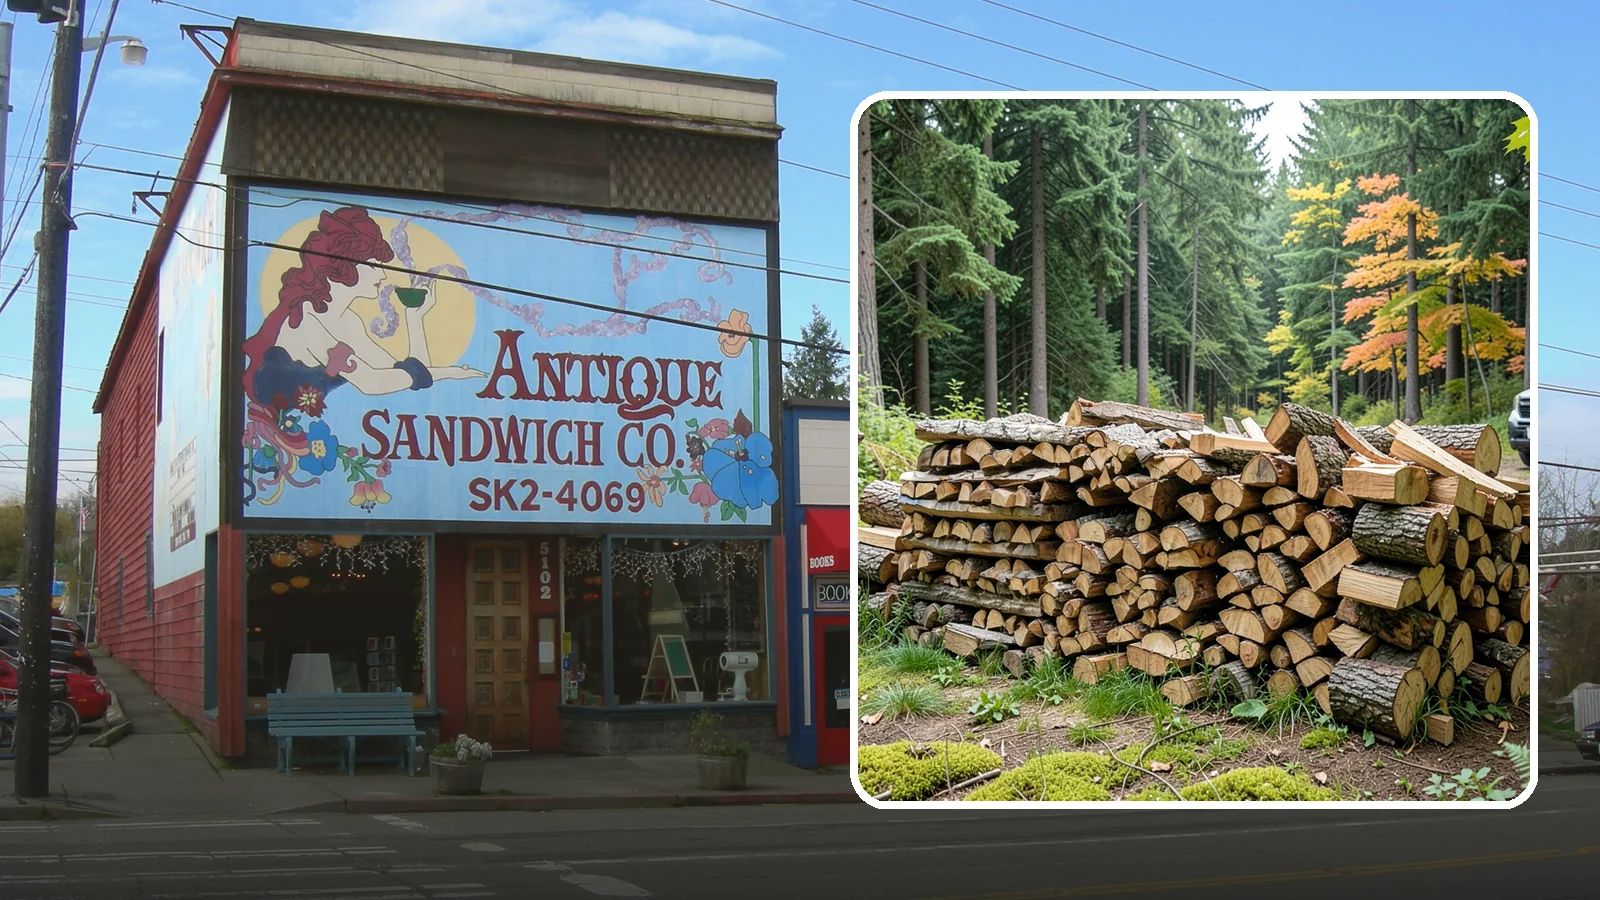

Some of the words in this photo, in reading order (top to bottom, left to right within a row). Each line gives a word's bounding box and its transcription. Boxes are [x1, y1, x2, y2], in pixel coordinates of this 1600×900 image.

[476, 329, 723, 421] ANTIQUE
[361, 409, 604, 467] SANDWICH
[617, 422, 685, 469] CO.
[469, 477, 645, 512] SK2-4069
[540, 541, 551, 599] 5102
[809, 555, 835, 569] BOOKS
